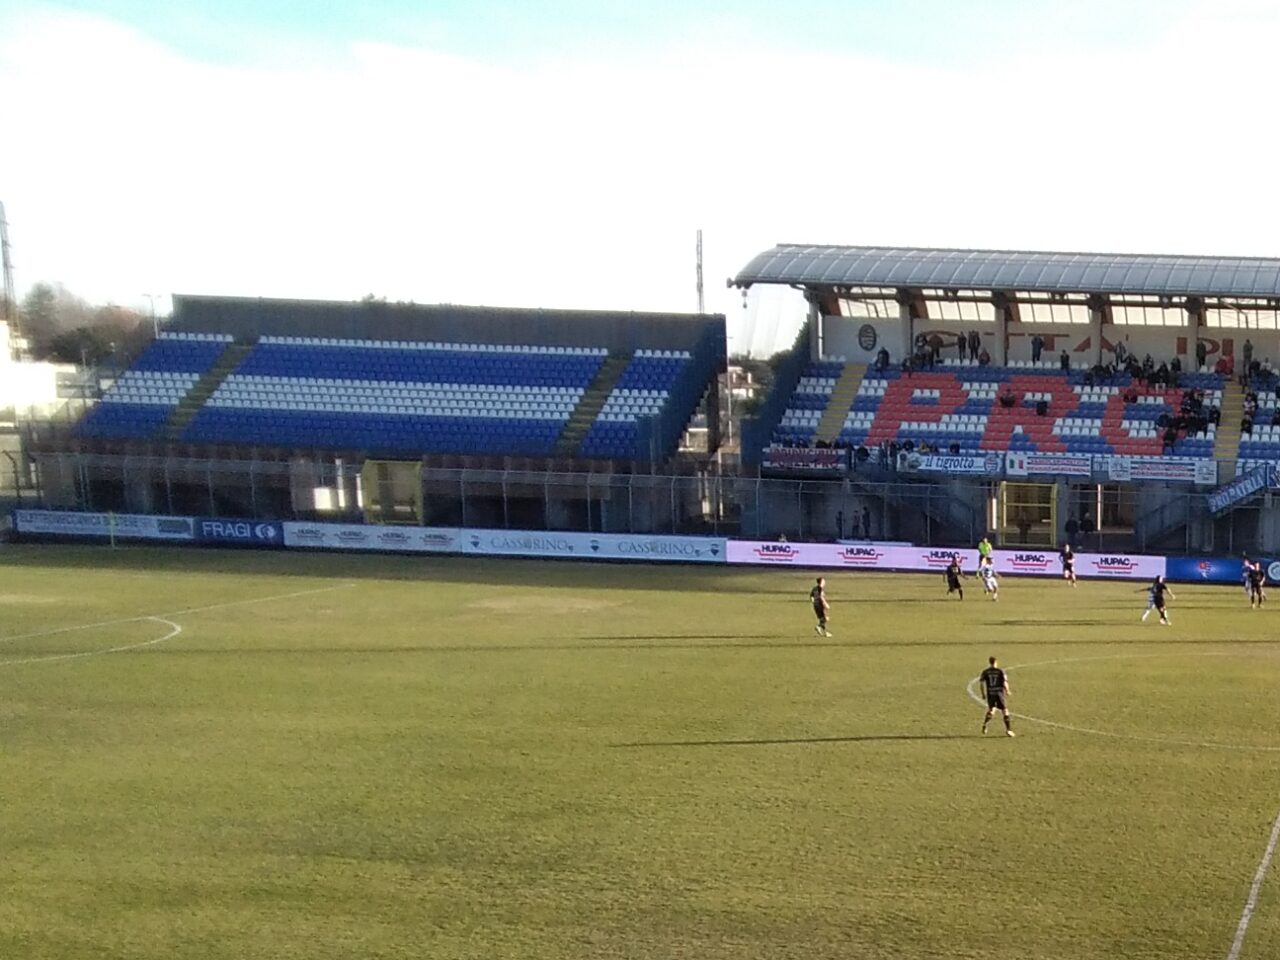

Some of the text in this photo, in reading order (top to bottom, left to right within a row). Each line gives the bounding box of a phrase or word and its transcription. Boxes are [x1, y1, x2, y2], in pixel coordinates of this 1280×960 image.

[203, 521, 250, 539] FRAGI
[762, 544, 791, 553] HUPAC
[845, 548, 875, 556] HUPAC
[1014, 554, 1045, 563] HUPAC
[1100, 557, 1130, 566] HUPAC
